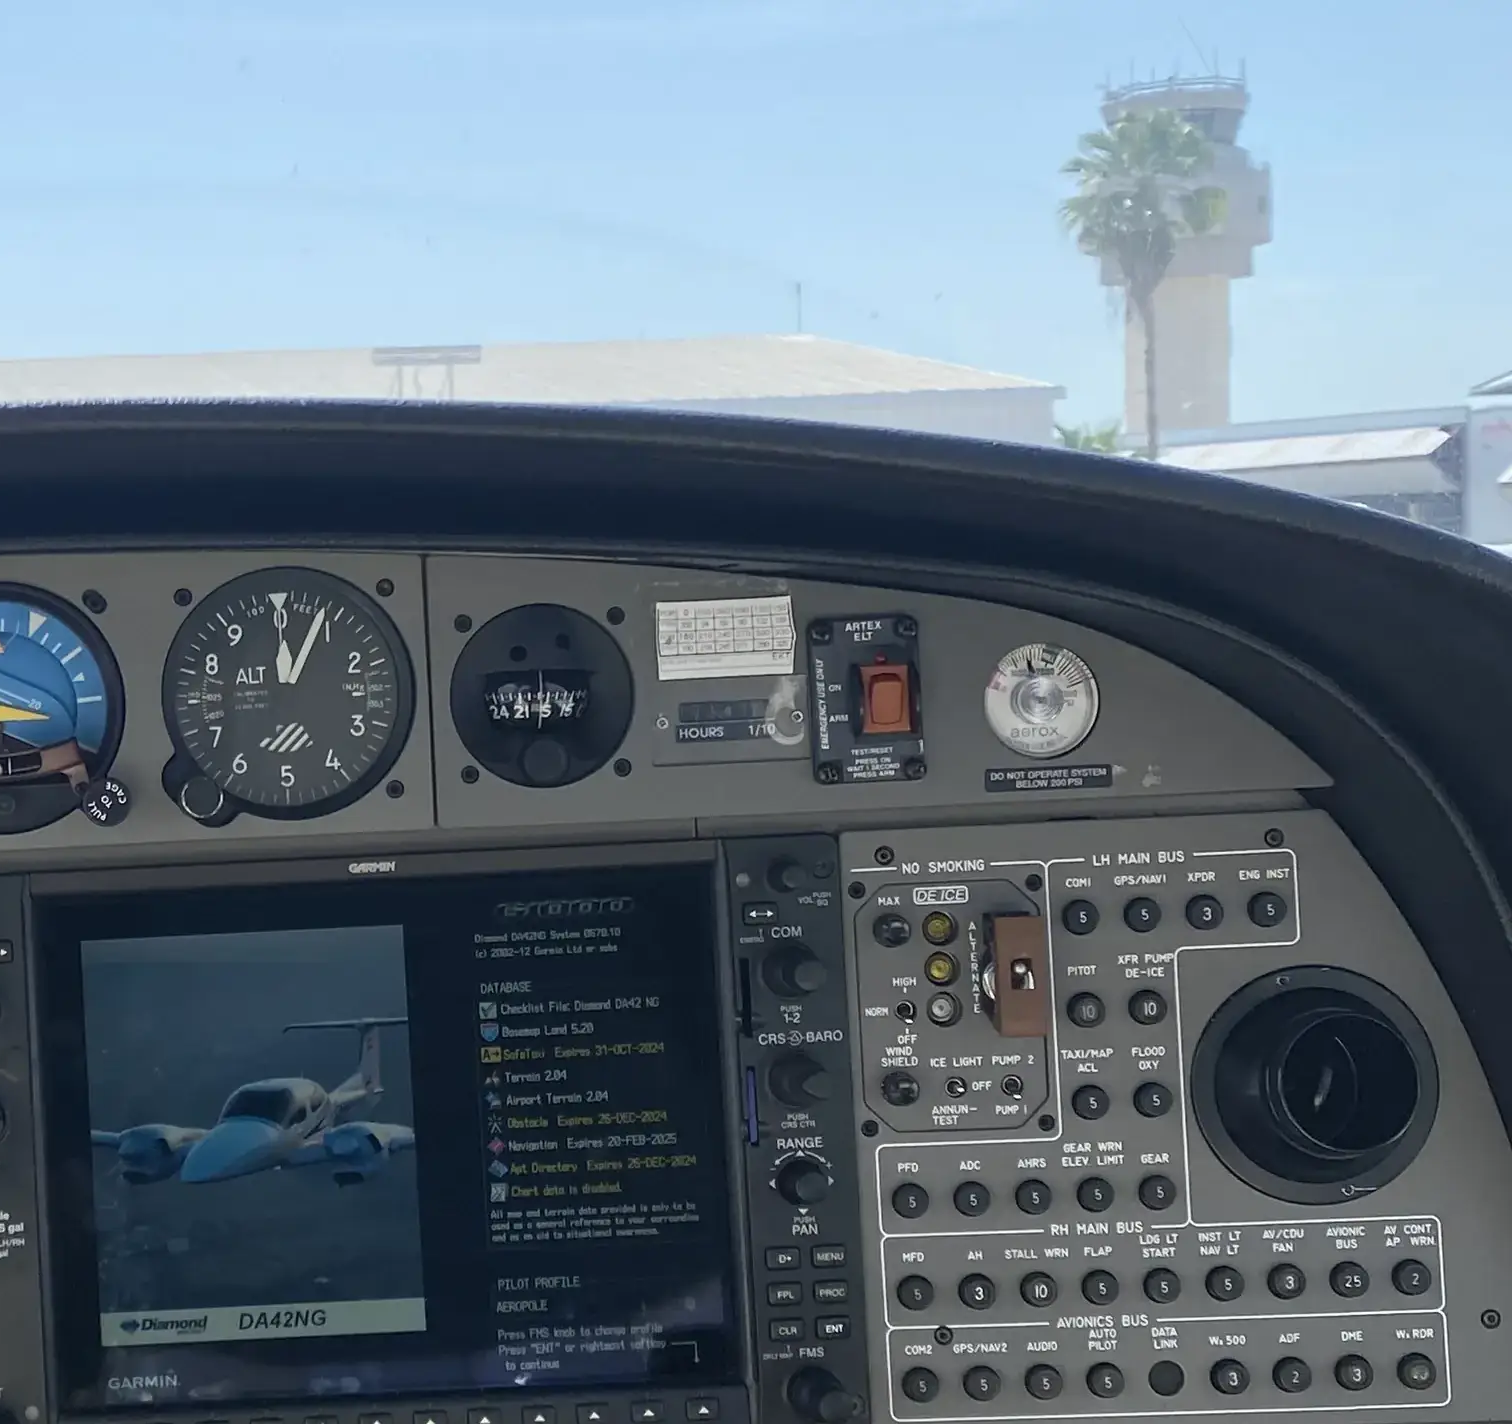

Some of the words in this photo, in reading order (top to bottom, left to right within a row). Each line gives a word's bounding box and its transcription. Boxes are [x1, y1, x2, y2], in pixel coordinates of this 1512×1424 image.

[845, 621, 881, 632] ARTEX
[854, 632, 872, 641] ELT
[205, 654, 219, 674] 8
[236, 667, 266, 685] ALT
[680, 727, 724, 739] HOURS
[748, 724, 776, 736] 1/10
[1011, 725, 1059, 738] aerox
[281, 766, 294, 786] 5
[990, 771, 1005, 780] DO
[1007, 771, 1026, 779] NOT
[1028, 768, 1068, 779] OPERATE
[1071, 768, 1106, 778] SYSTEM
[1016, 779, 1049, 788] BELOW
[1051, 778, 1066, 787] 200
[1068, 778, 1082, 786] PSI
[1093, 855, 1110, 866] LH
[1118, 853, 1151, 865] MAIN
[1158, 851, 1185, 863] BUS
[349, 862, 395, 874] GARMIN
[902, 863, 920, 874] NO
[928, 860, 985, 872] SMOKING
[1188, 872, 1216, 882] XPDR
[1239, 870, 1260, 880] ENG
[1266, 869, 1289, 879] INST
[878, 897, 900, 906] MAX
[917, 891, 935, 901] DE
[938, 890, 965, 901] ICE
[969, 921, 981, 1014] ALTERNATE
[1068, 966, 1096, 975] PITOT
[480, 982, 532, 994] DATABASE
[886, 1047, 912, 1056] WIND
[881, 1057, 918, 1066] SHIELD
[930, 1058, 946, 1067] ICE
[953, 1056, 983, 1066] LIGHT
[898, 1163, 918, 1172] PFD
[1018, 1158, 1046, 1168] AHRS
[8, 1223, 24, 1235] gal
[1051, 1224, 1069, 1236] RH
[1076, 1223, 1109, 1234] MAIN
[1116, 1222, 1143, 1233] BUS
[1005, 1249, 1037, 1259] STALL
[1044, 1248, 1068, 1258] WRN
[498, 1278, 529, 1290] PILOT
[535, 1277, 580, 1288] PROFILE
[141, 1316, 207, 1331] Diamond
[239, 1309, 326, 1331] DA42NG
[1057, 1316, 1114, 1328] AVIONICS
[1122, 1315, 1148, 1326] BUS
[1342, 1331, 1363, 1341] DME
[905, 1345, 932, 1354] COM2
[953, 1342, 1008, 1354] GPS/NAV2
[1027, 1341, 1058, 1351] AUDIO
[108, 1374, 177, 1390] GARMIN
